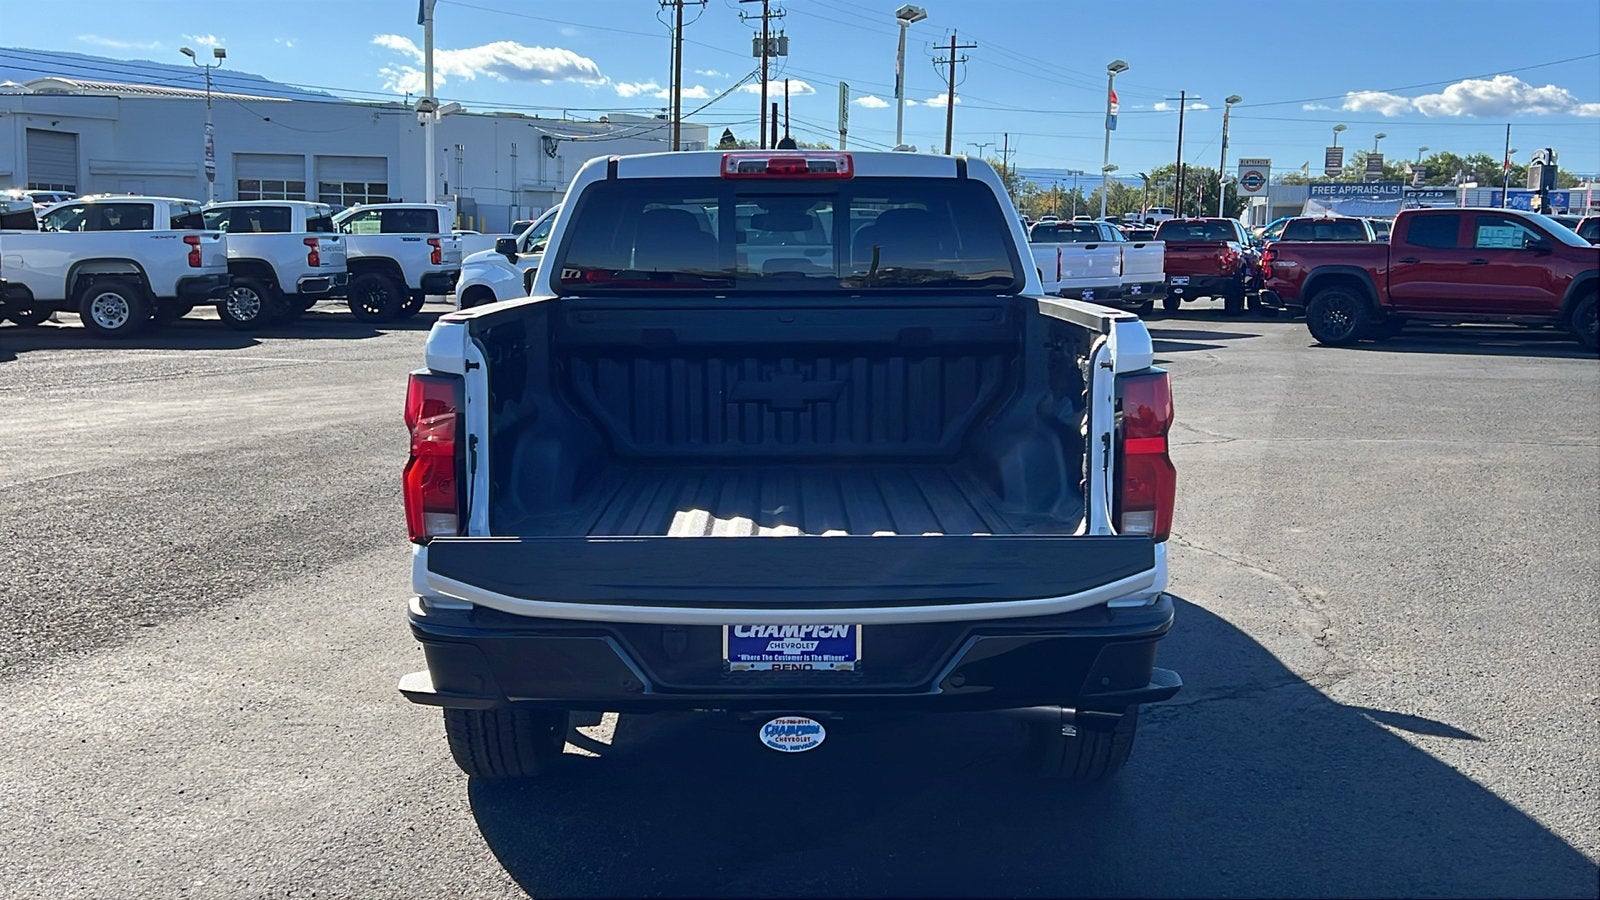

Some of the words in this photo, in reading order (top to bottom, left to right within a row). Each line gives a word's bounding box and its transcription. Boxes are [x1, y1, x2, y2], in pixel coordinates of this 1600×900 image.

[1311, 186, 1337, 195] FREE
[1338, 185, 1400, 195] APPRAISALS!
[734, 624, 850, 638] CHAMPION
[764, 723, 820, 738] CHAMPION
[789, 740, 819, 751] NEVADA
